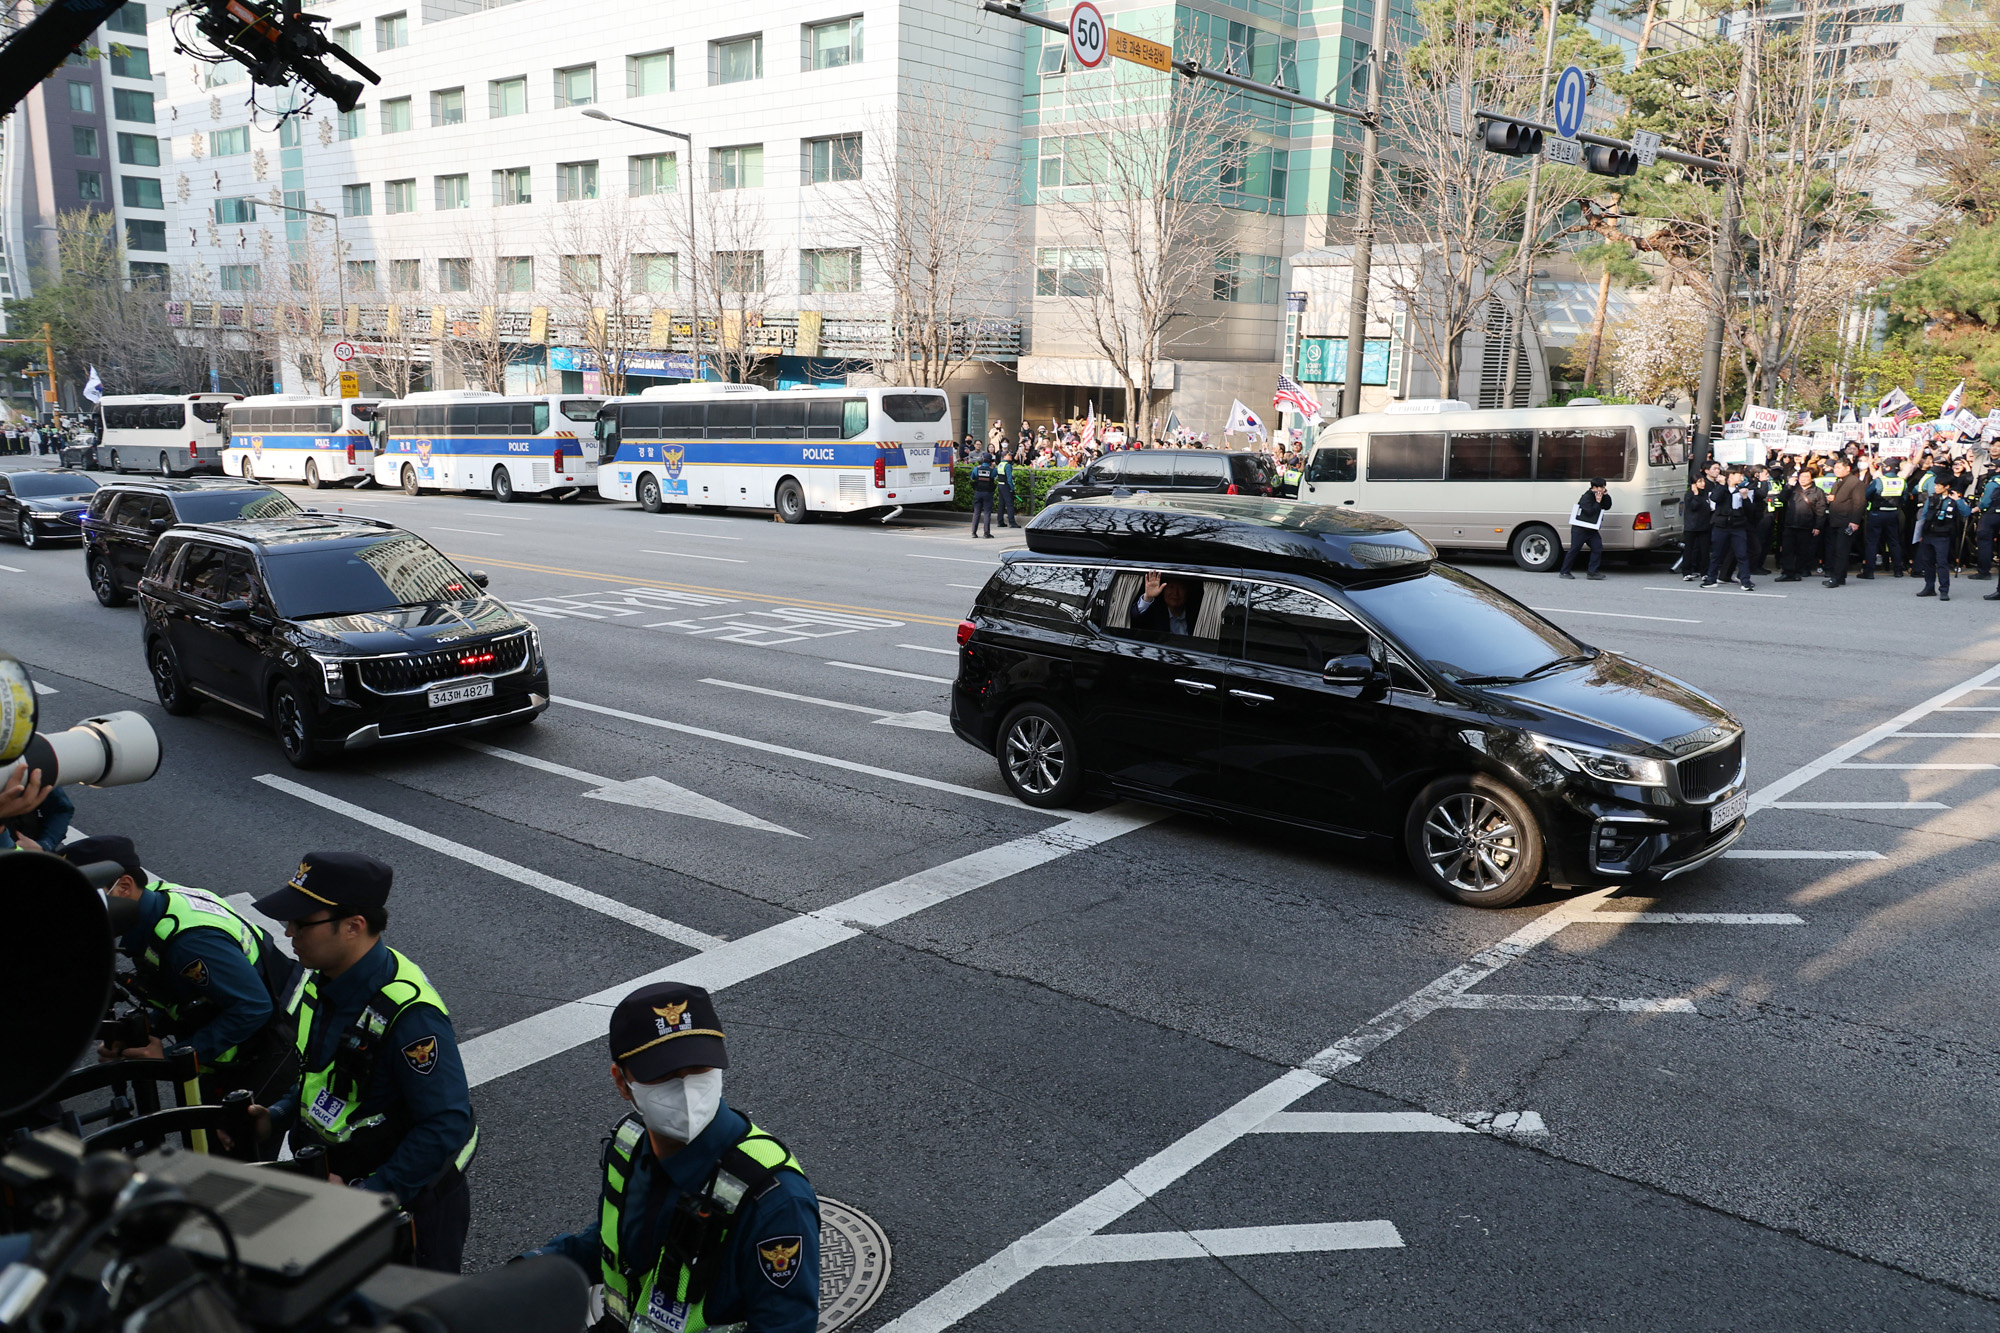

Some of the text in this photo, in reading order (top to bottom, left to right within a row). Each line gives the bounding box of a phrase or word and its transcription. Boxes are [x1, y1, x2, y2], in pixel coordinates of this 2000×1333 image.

[1077, 18, 1099, 50] 50
[1115, 36, 1165, 66] 신호 과속 단속장비
[337, 347, 351, 357] 50
[645, 359, 665, 369] BANK
[1755, 410, 1779, 423] YOON
[1749, 420, 1777, 431] AGAIN
[314, 438, 330, 447] POLICE
[508, 442, 530, 452] POLICE
[802, 448, 835, 461] POLICE
[909, 448, 930, 457] POLICE
[433, 684, 489, 704] 343머 4827
[417, 1060, 433, 1069] POLICE
[317, 1091, 342, 1115] 경찰
[311, 1106, 333, 1125] POLICE
[772, 1270, 792, 1278] POLICE
[649, 1306, 682, 1330] POLICE
